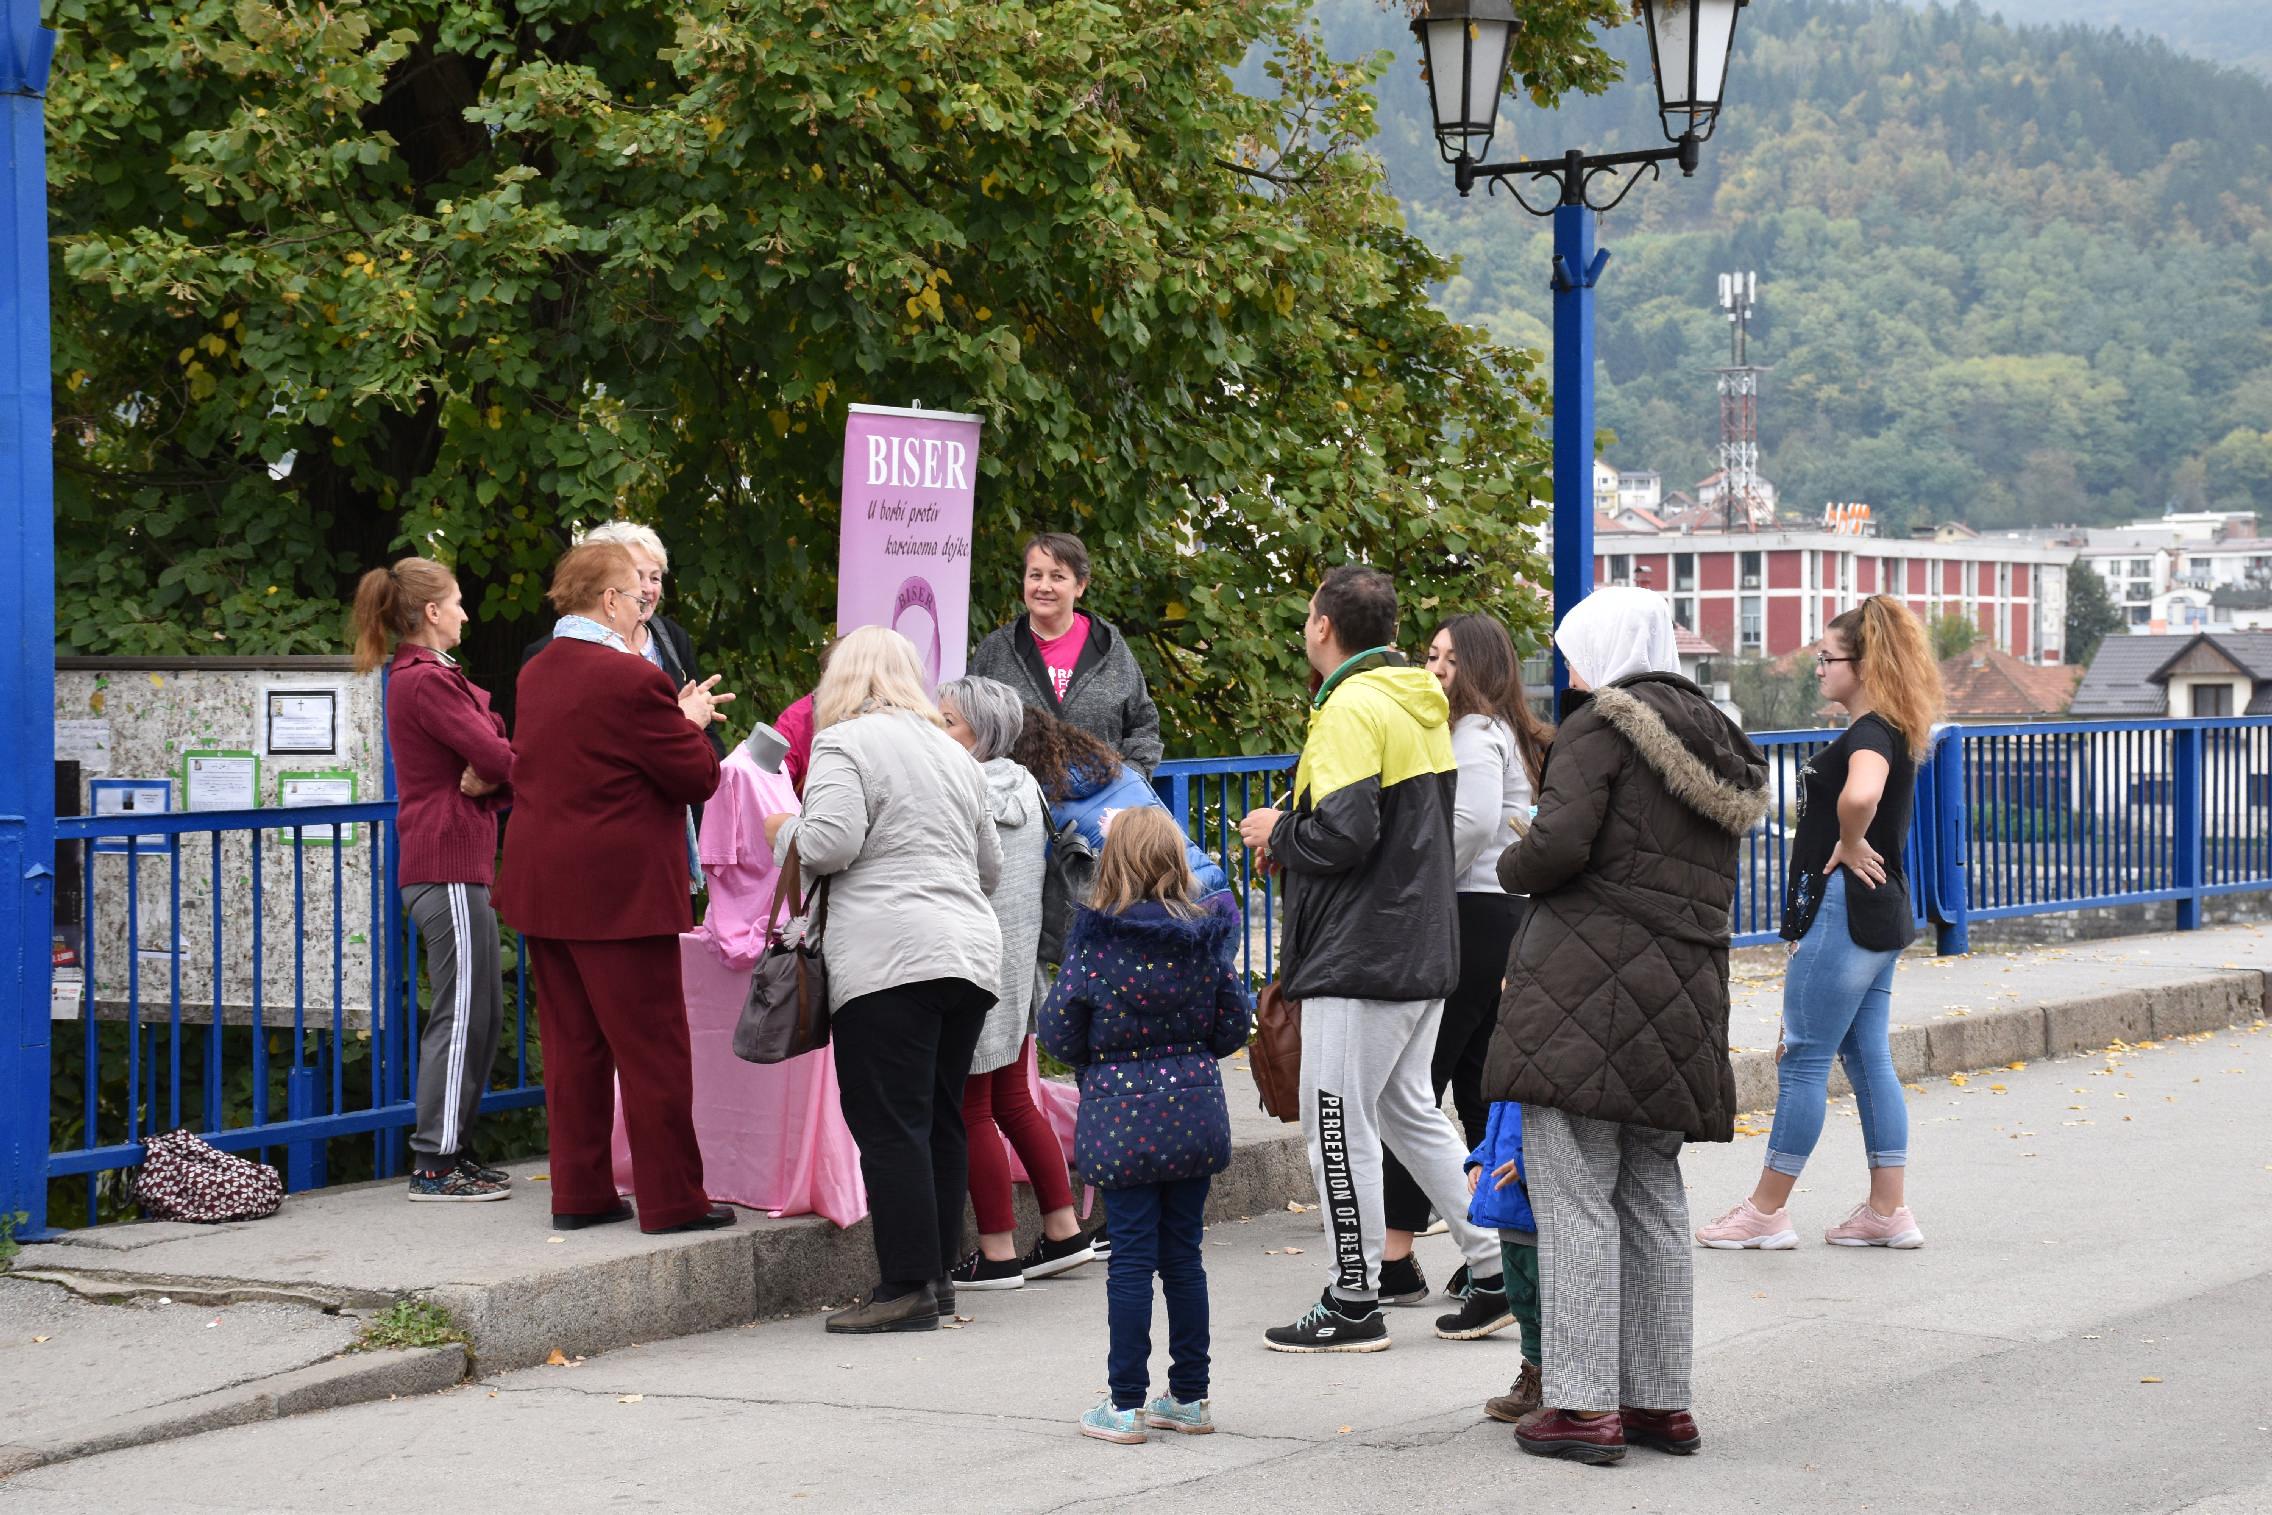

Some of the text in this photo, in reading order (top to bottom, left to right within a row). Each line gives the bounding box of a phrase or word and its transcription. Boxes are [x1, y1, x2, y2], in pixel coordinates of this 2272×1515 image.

[866, 435, 968, 489] BISER
[867, 500, 941, 528] U borbi protiv
[884, 535, 938, 557] karcinoma
[898, 586, 933, 609] BISER
[1058, 669, 1073, 678] RA
[1322, 1097, 1363, 1291] PERCEPTION OF REALITY
